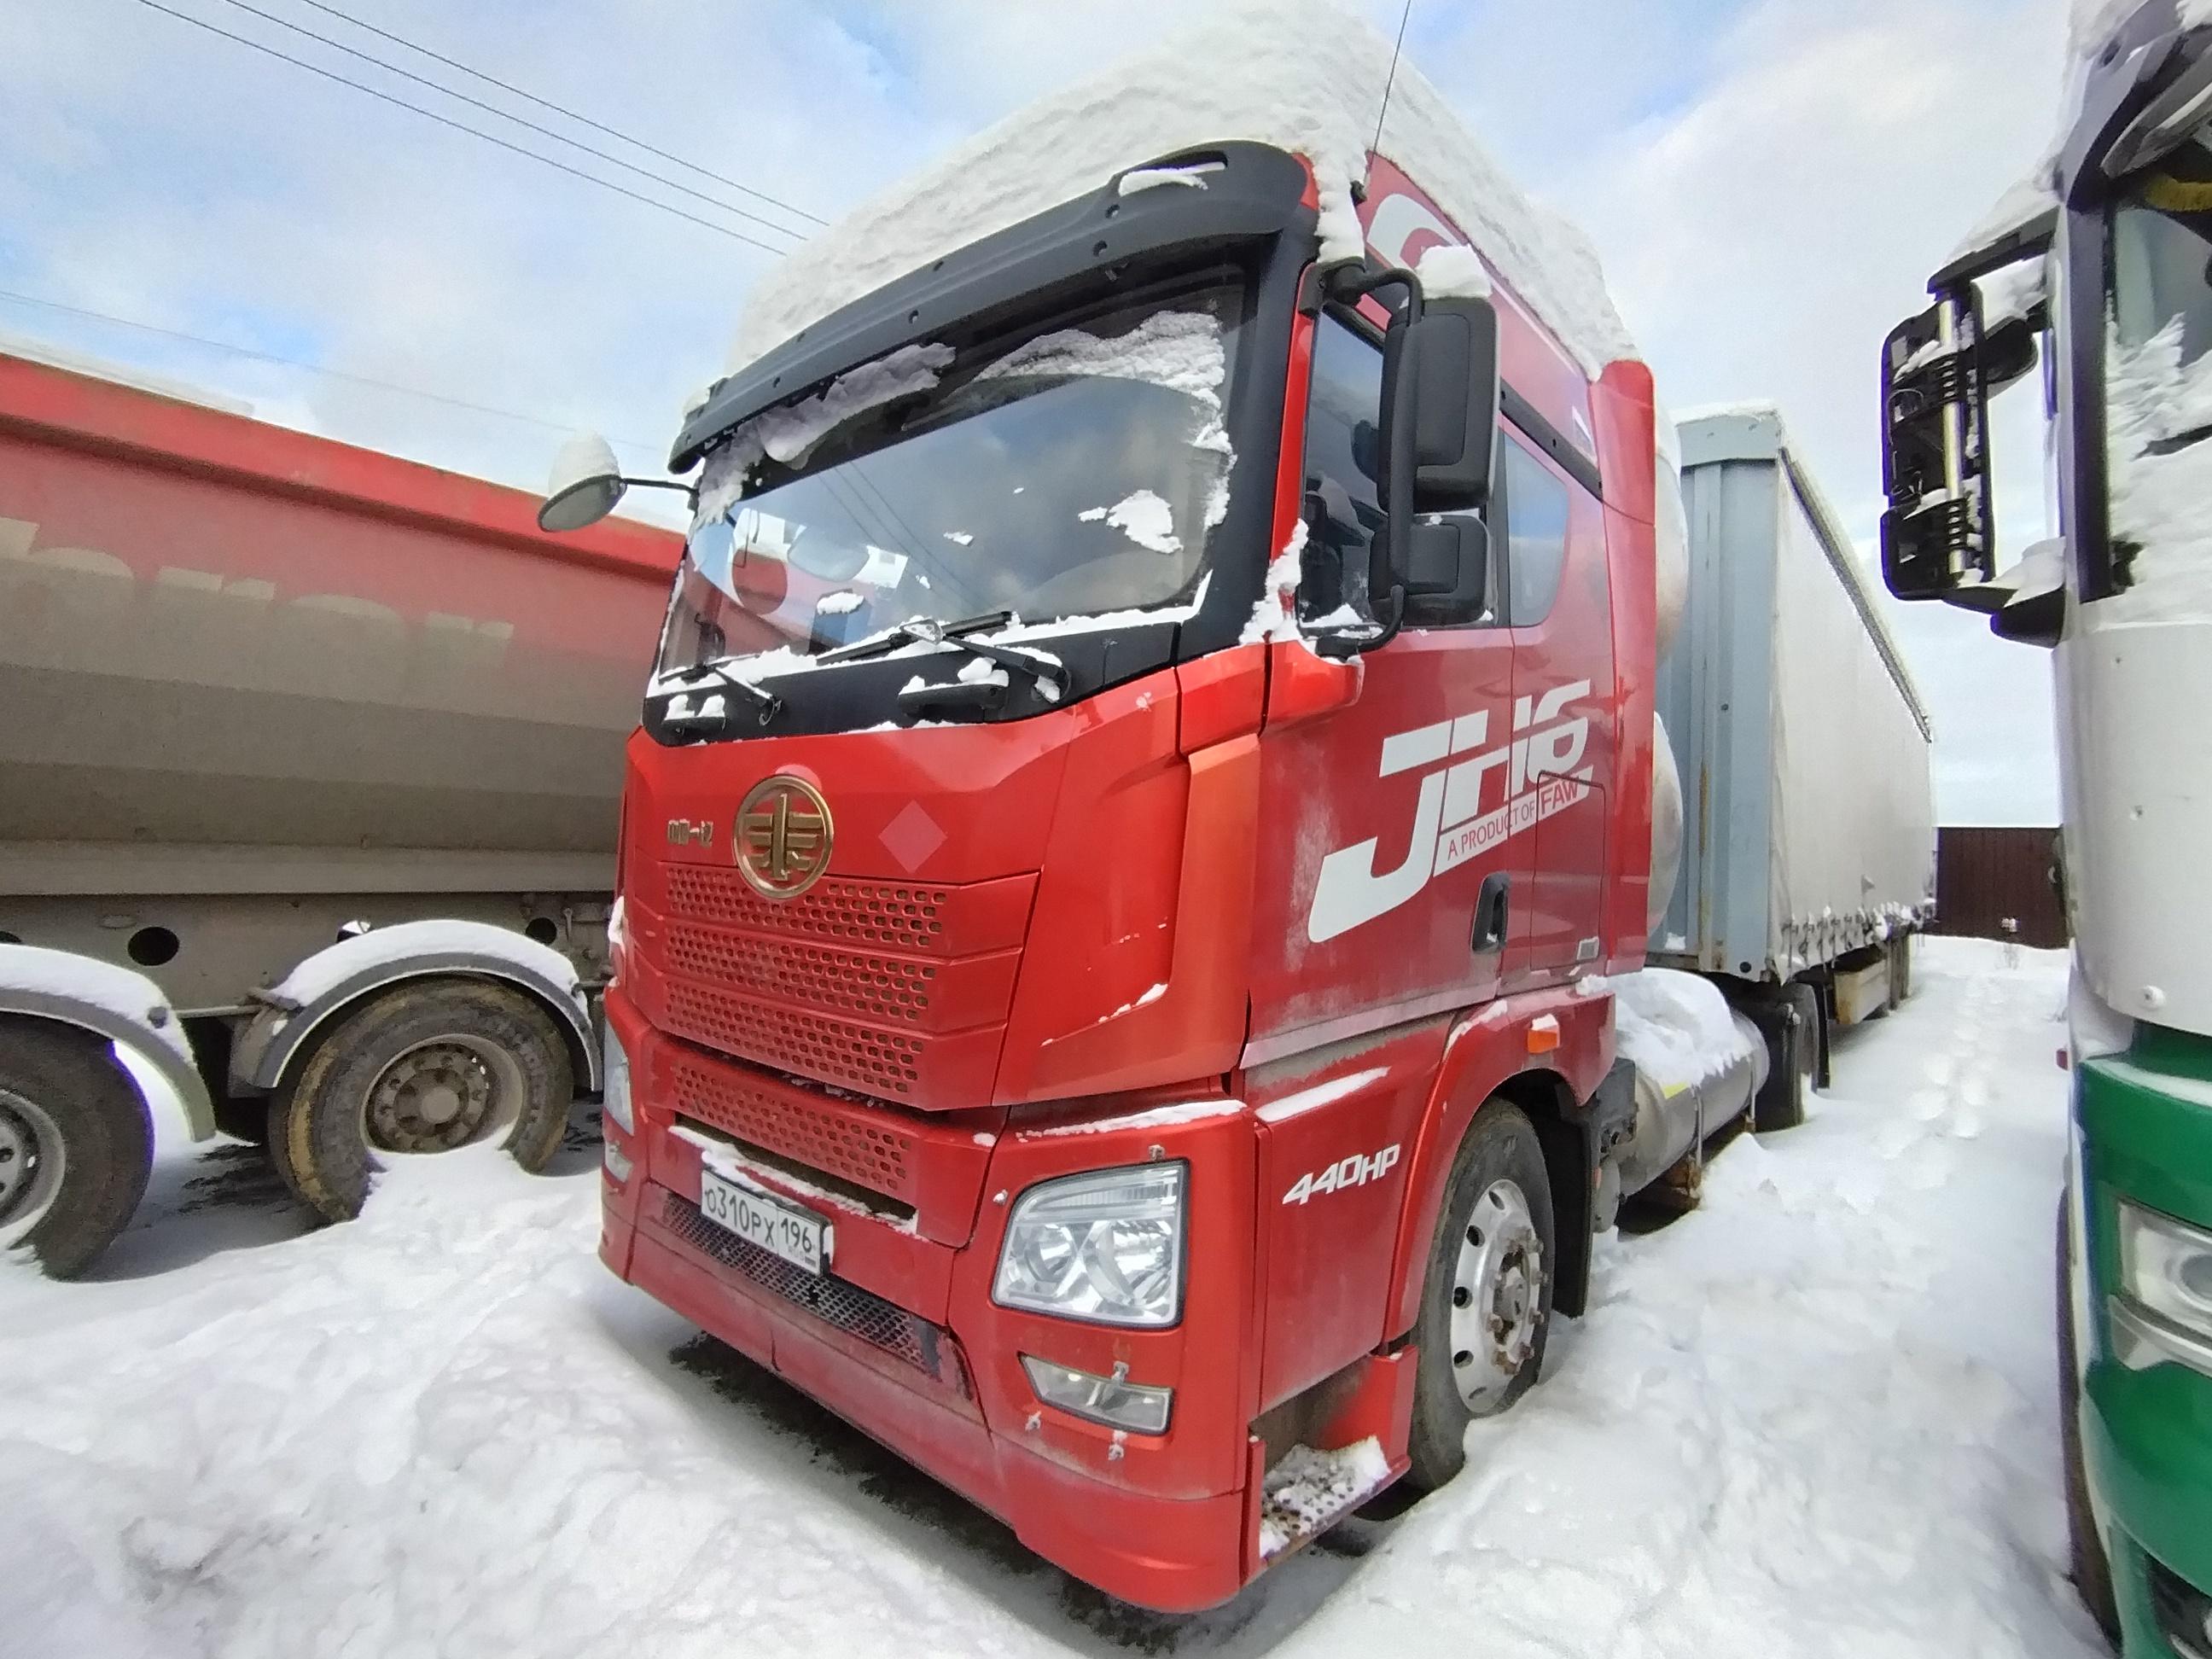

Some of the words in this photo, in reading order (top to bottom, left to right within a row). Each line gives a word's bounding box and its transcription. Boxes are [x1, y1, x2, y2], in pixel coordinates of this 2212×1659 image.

[1447, 840, 1458, 861] A
[1460, 807, 1521, 855] PRODUCT
[1521, 801, 1536, 821] OF
[1540, 778, 1579, 815] FAW
[1282, 1143, 1401, 1206] 440HP
[781, 1217, 812, 1253] 196
